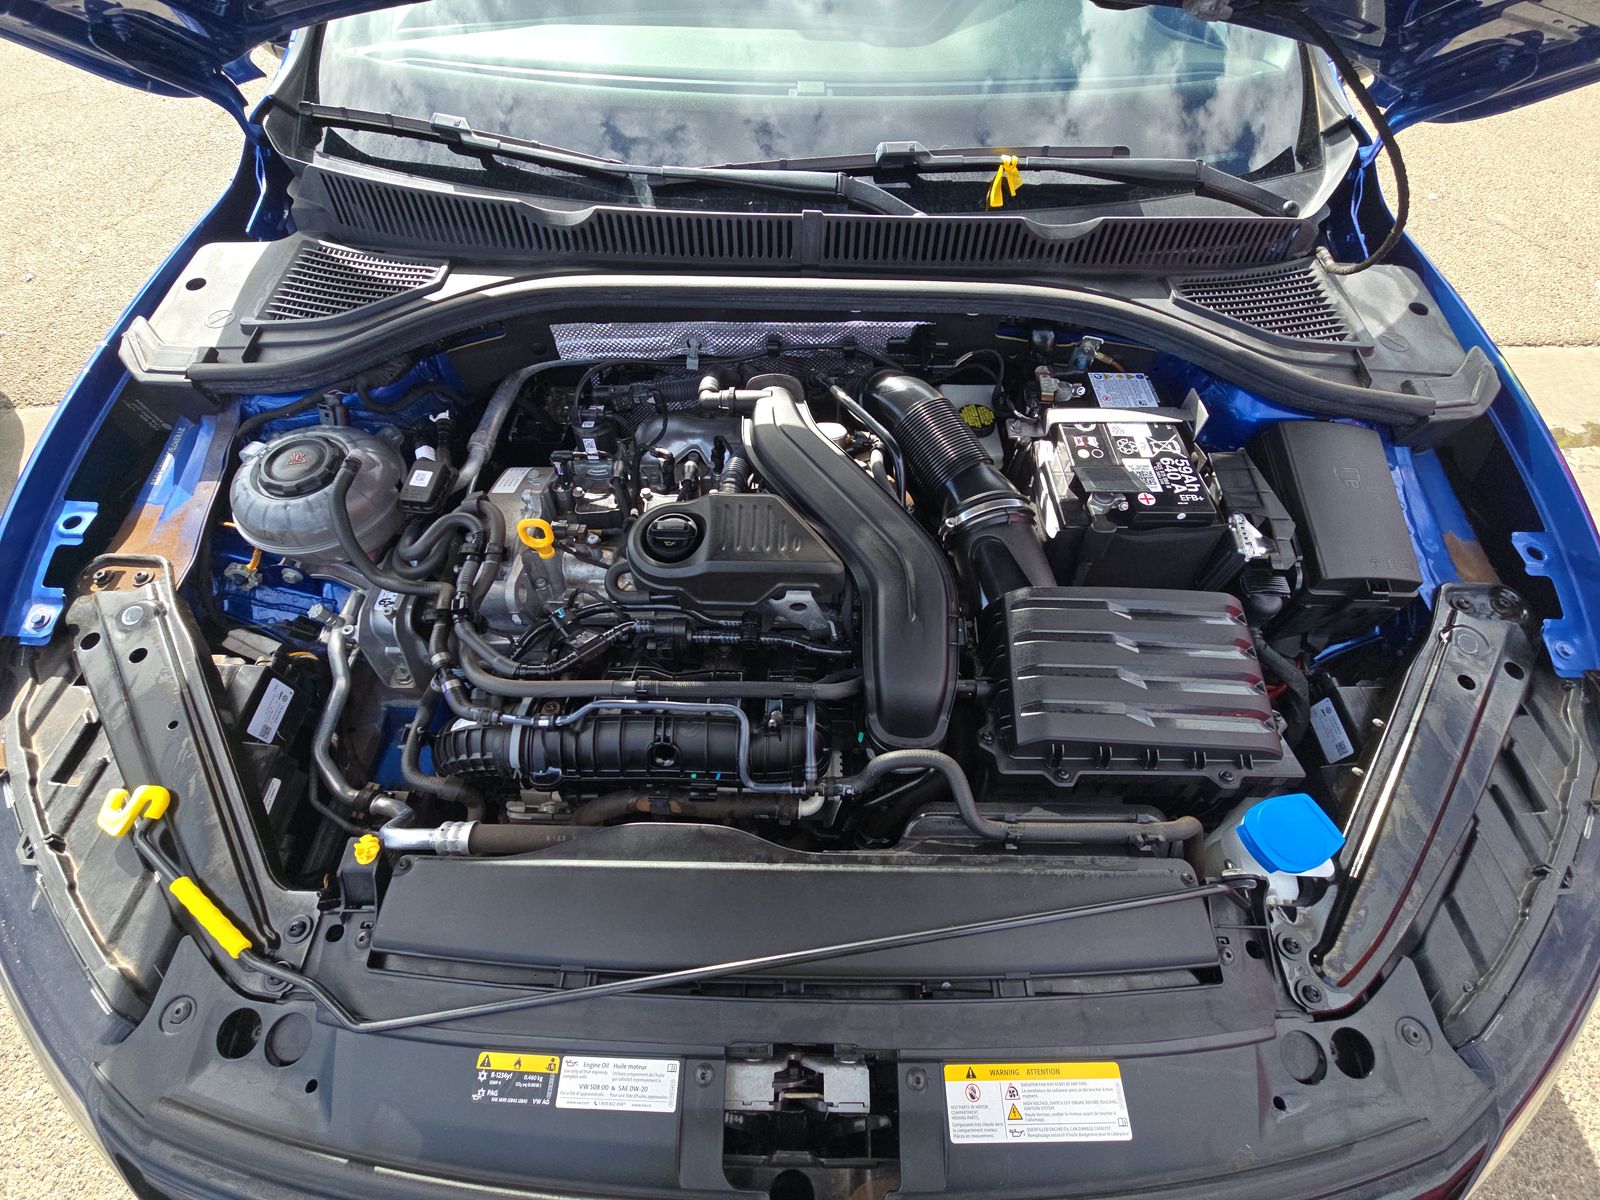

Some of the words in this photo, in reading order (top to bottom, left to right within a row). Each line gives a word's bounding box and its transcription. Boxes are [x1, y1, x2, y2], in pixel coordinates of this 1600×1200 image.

[1160, 457, 1181, 480] 640
[1171, 483, 1188, 493] A
[1174, 459, 1200, 492] 59Ah
[1179, 494, 1204, 502] EFB+
[490, 1072, 513, 1080] R-1234yf
[1026, 1068, 1060, 1076] ATTENTION
